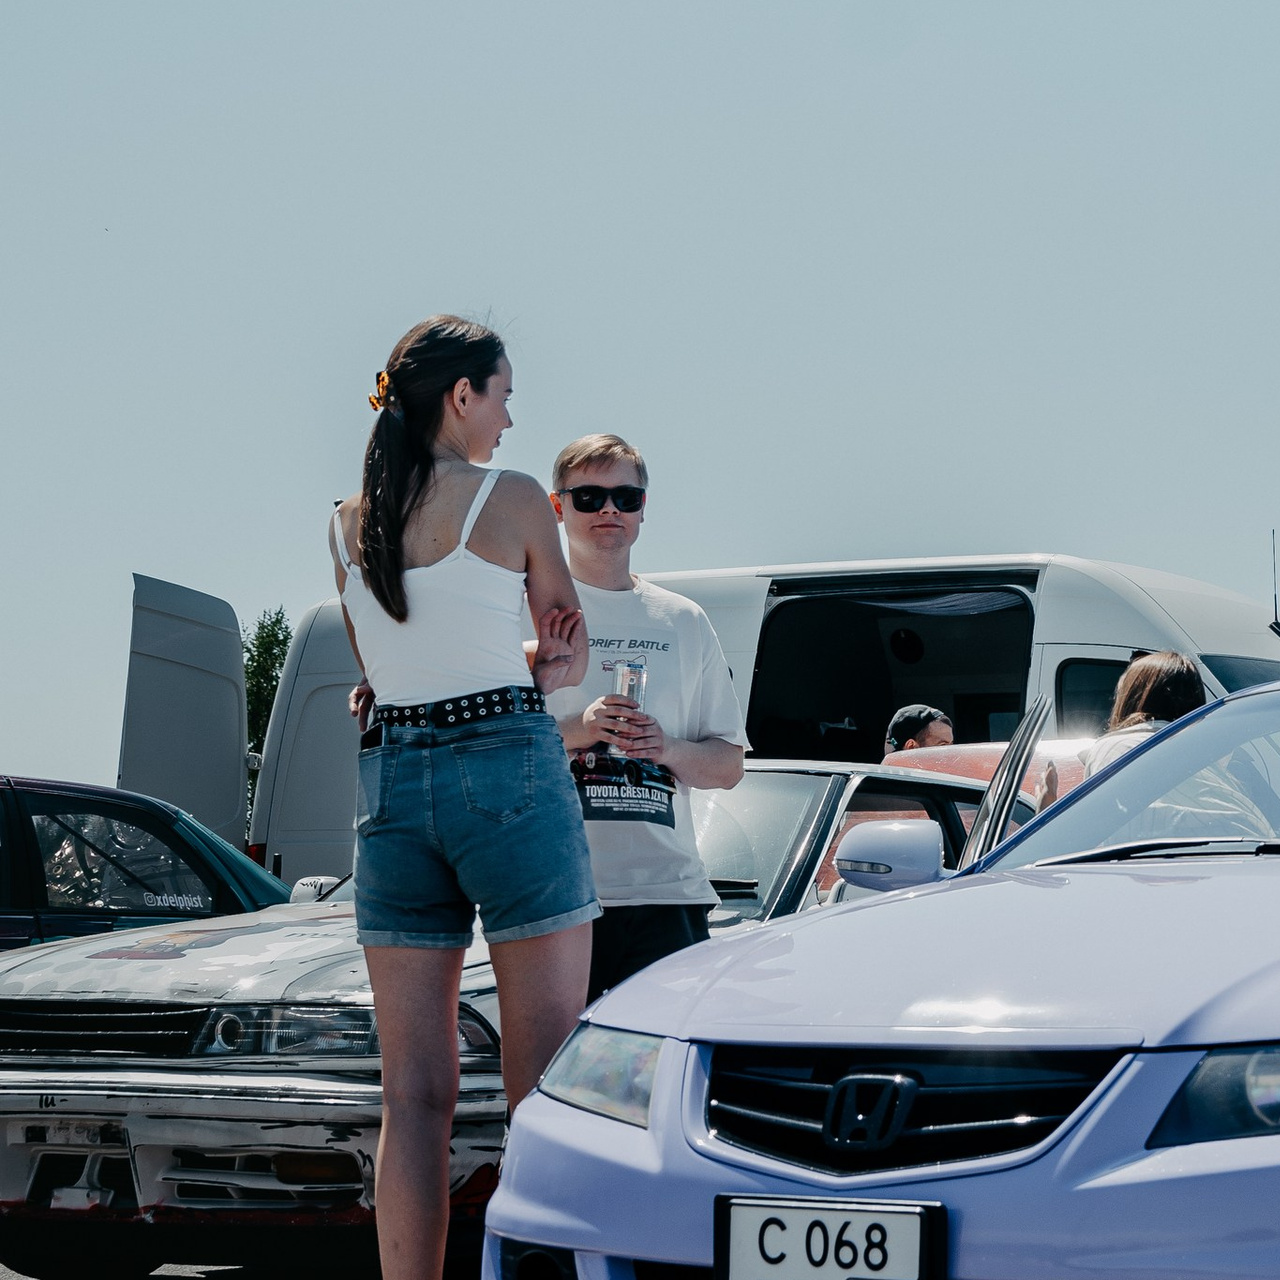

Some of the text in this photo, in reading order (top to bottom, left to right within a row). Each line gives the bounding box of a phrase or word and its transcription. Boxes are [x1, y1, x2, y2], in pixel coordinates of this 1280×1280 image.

[589, 638, 625, 649] DRIFT
[628, 639, 670, 652] BATTLE
[585, 785, 619, 798] TOYOTA
[620, 786, 649, 800] CRESTA
[758, 1217, 888, 1271] C 068
